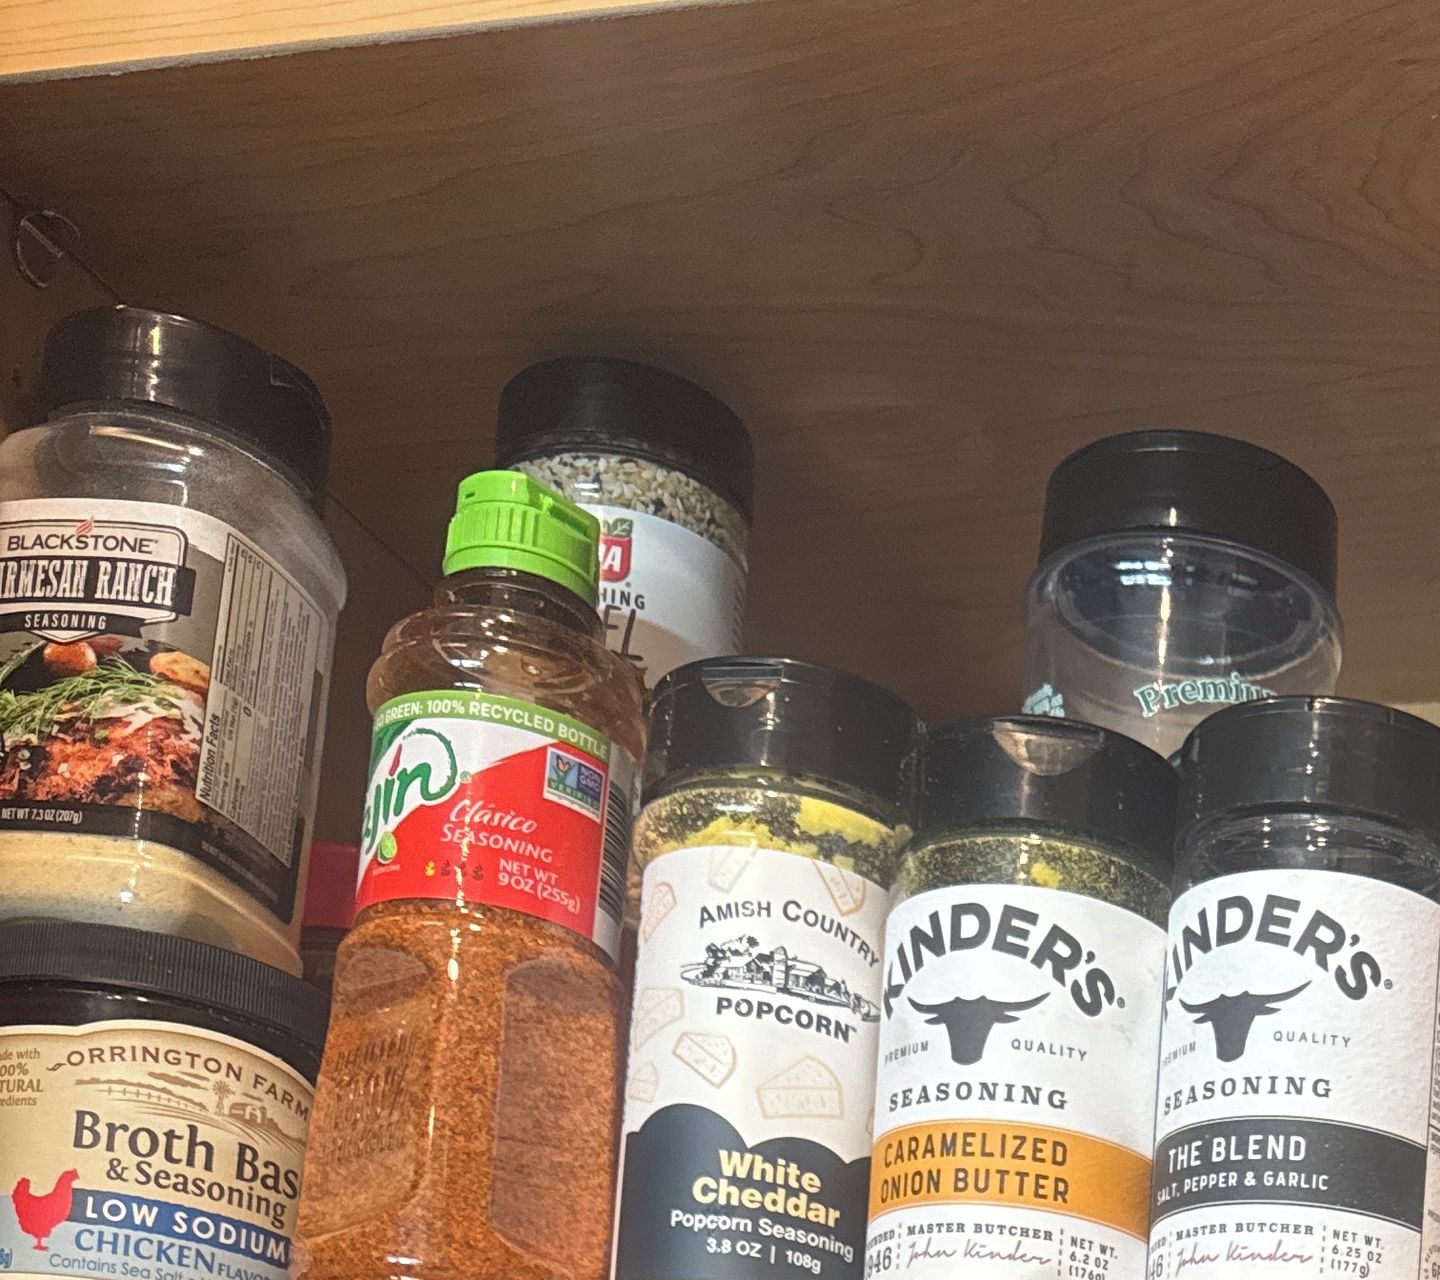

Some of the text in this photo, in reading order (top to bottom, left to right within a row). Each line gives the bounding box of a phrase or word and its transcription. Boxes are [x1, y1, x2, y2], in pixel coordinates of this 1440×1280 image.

[8, 533, 154, 554] BLACKSTONE
[94, 560, 176, 606] RANCH
[24, 614, 106, 629] SEASONING
[384, 699, 608, 758] GREEN: 100% RECYCLED BOTTLE
[450, 800, 536, 833] Clásico
[441, 824, 552, 863] SEASONING
[883, 902, 1117, 1019] KINDER'S
[716, 997, 850, 1044] POPCORN
[67, 1046, 243, 1082] ORRINGTON
[1011, 1039, 1088, 1061] QUALITY
[889, 1081, 1068, 1112] SEASONING
[1164, 1076, 1332, 1116] SEASONING
[73, 1110, 214, 1172] Broth
[884, 1131, 1068, 1169] CARAMELIZED
[1168, 1134, 1306, 1174] THE BLEND
[718, 1149, 821, 1193] White
[881, 1167, 1069, 1204] ONION BUTTER
[1157, 1170, 1329, 1206] SALT, PEPPER & GARLIC
[106, 1158, 287, 1230] & Seasoning
[692, 1176, 840, 1228] Cheddar
[86, 1196, 286, 1263] LOW SODIUM
[671, 1208, 854, 1264] Popcorn Seasoning
[907, 1223, 1053, 1242] MASTER BUTCHER
[1333, 1229, 1384, 1249] NET WT.
[50, 1252, 117, 1274] Contains
[121, 1262, 150, 1280] Sea
[74, 1228, 214, 1274] CHICKEN
[706, 1237, 821, 1274] 3.8 OZ 108g
[1330, 1259, 1369, 1278] (177g)
[1331, 1244, 1382, 1264] 6.25 OZ
